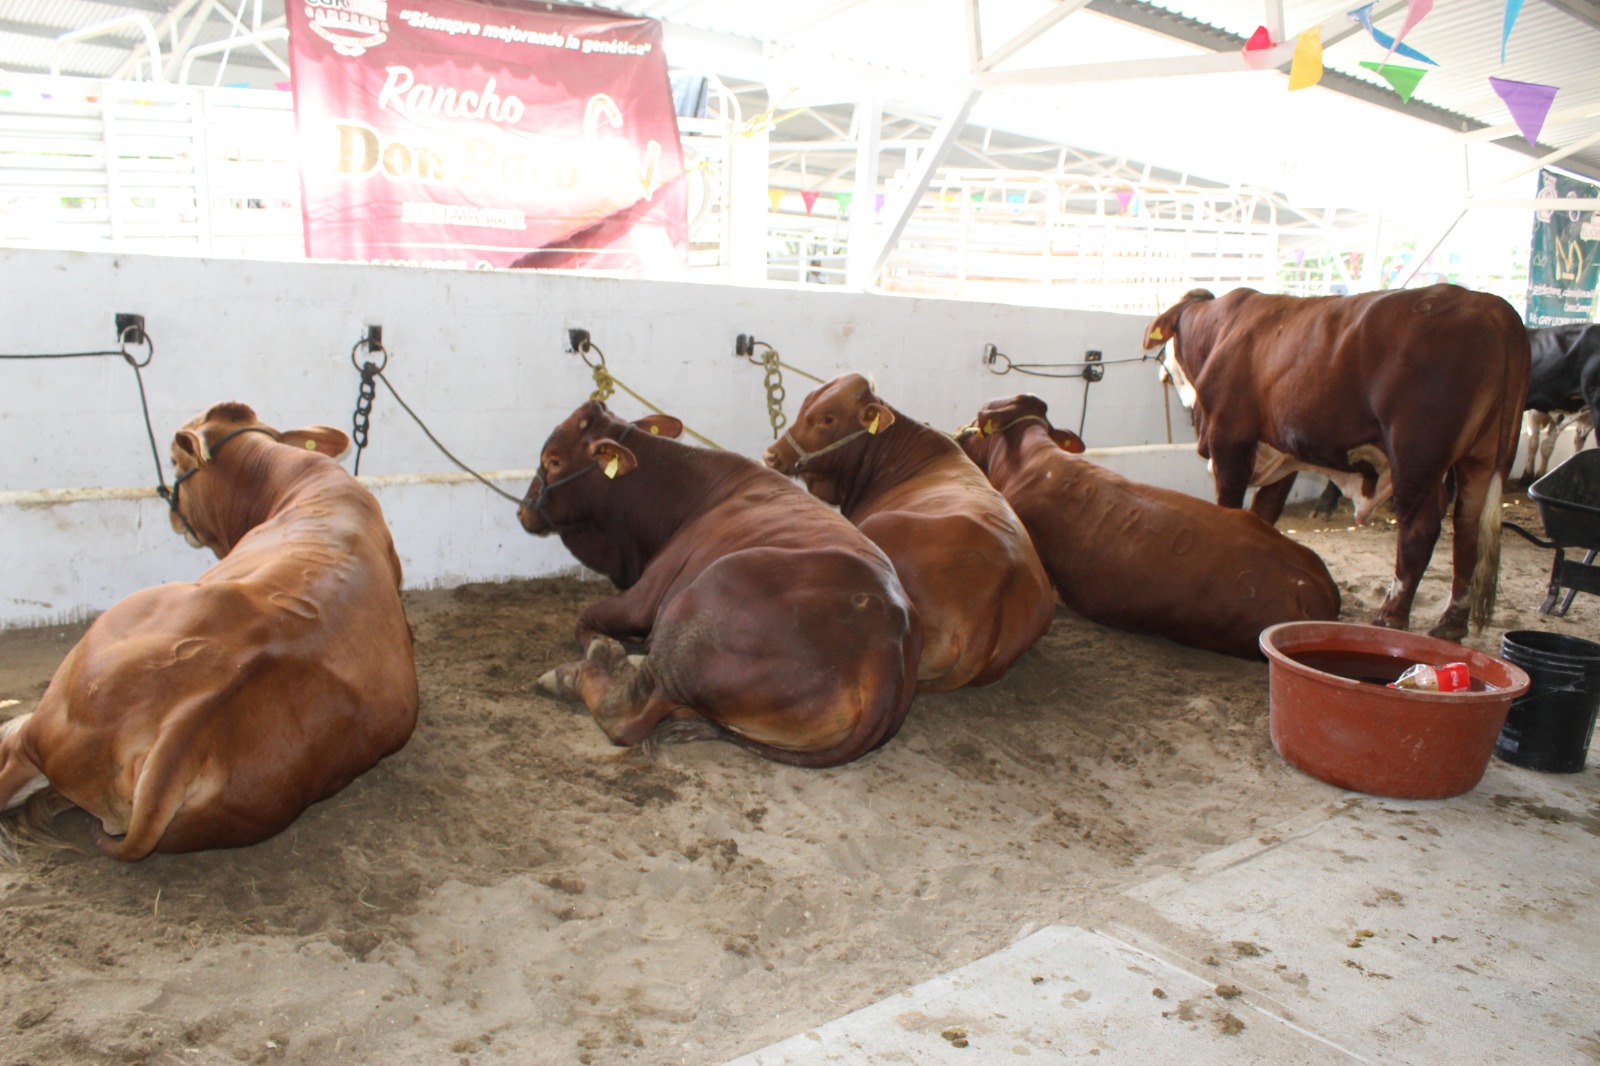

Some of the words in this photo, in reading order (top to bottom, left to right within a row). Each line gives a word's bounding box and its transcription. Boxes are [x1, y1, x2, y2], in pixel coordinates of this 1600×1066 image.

[482, 24, 563, 49] mejorando
[565, 34, 580, 49] la
[379, 66, 523, 123] Rancho
[334, 123, 447, 180] Don
